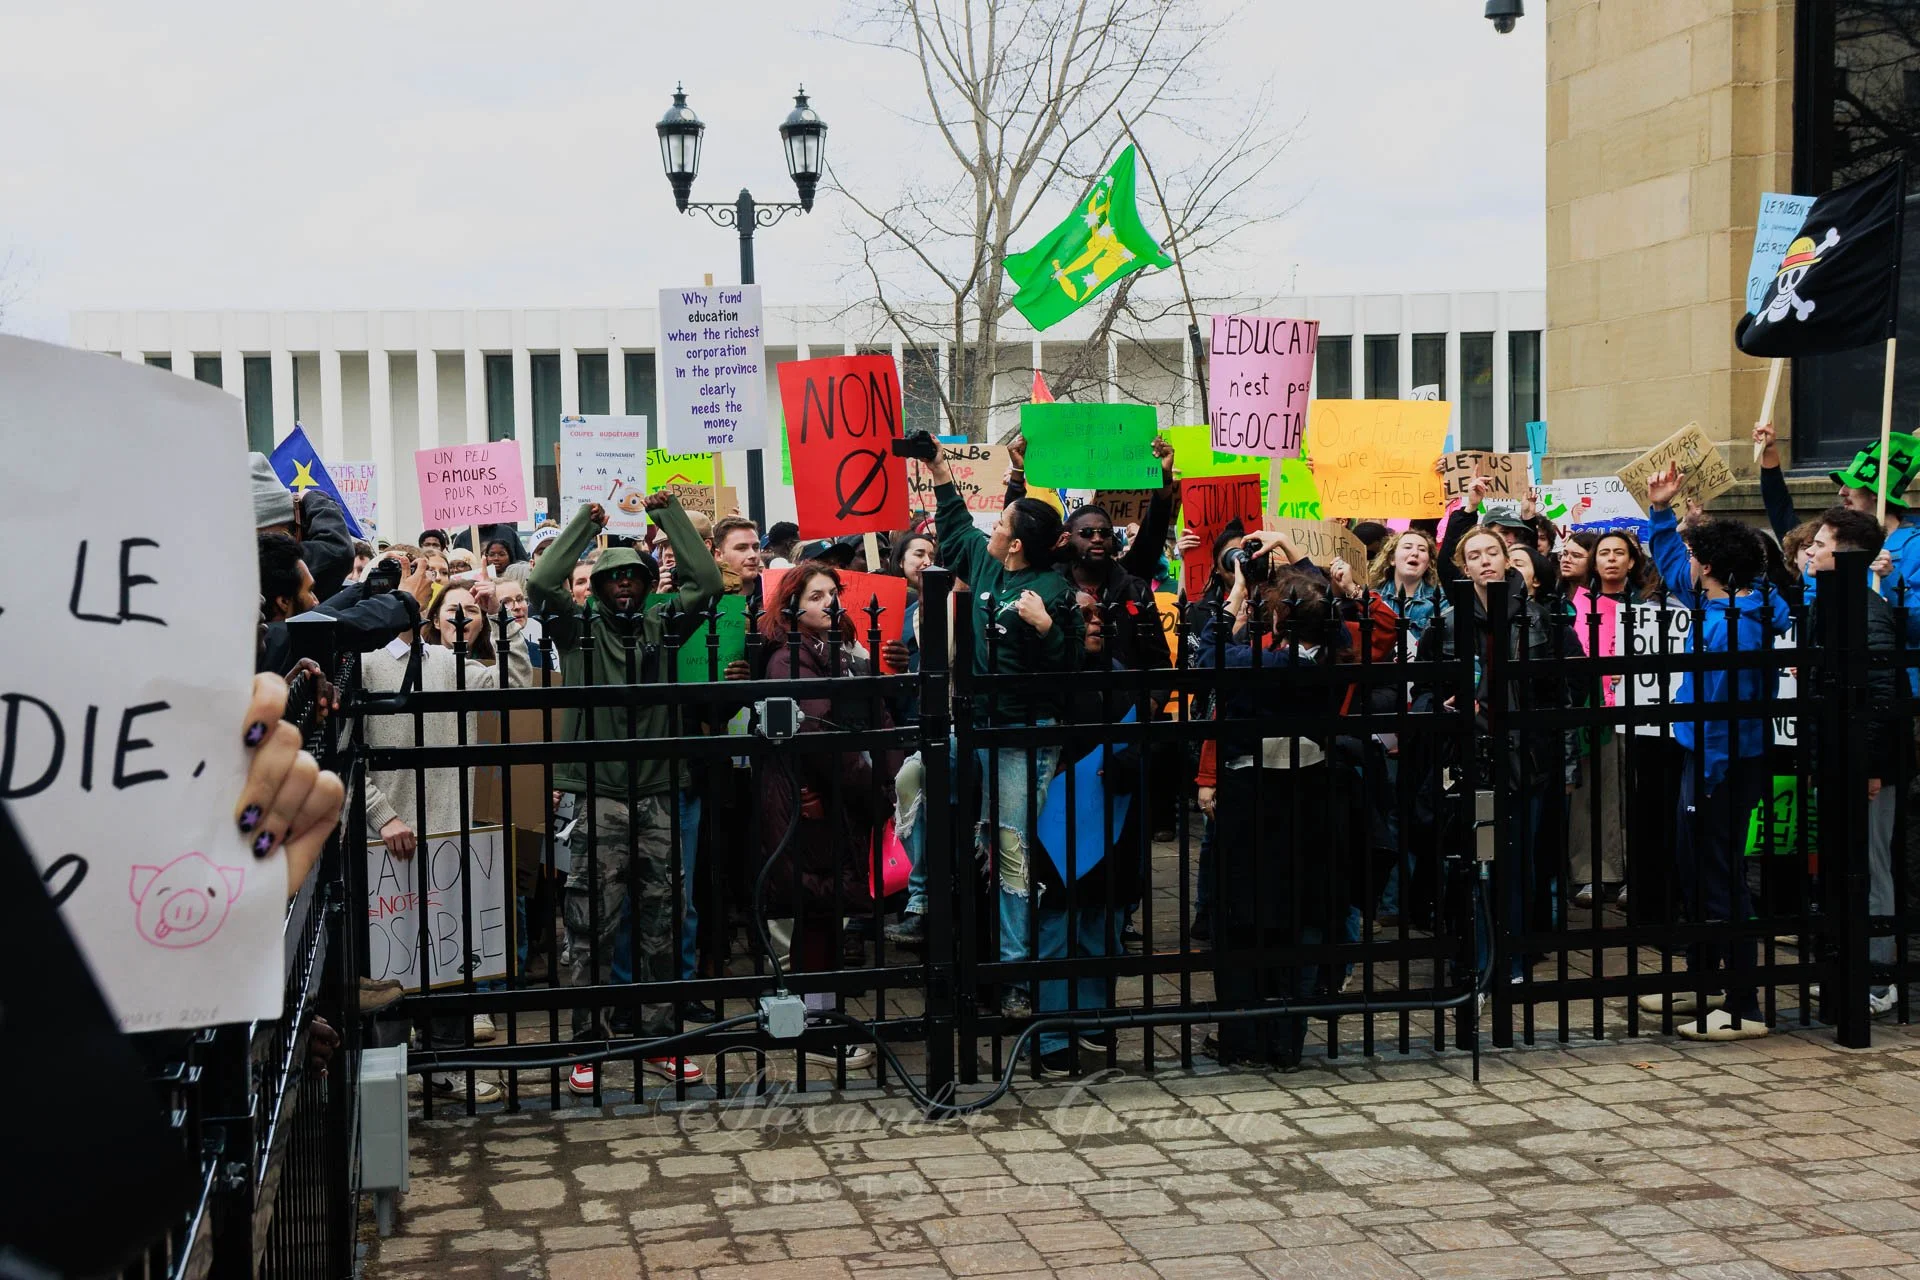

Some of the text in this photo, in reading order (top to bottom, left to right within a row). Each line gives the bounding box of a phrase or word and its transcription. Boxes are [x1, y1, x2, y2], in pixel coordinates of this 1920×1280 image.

[682, 291, 742, 307] Why fund
[688, 310, 739, 323] education
[668, 325, 760, 342] when the richest
[686, 345, 747, 360] corporation
[675, 363, 758, 379] in the province
[700, 383, 736, 399] clearly
[1230, 372, 1270, 398] n'est
[691, 401, 743, 415] needs the
[801, 371, 895, 444] NON
[703, 417, 738, 431] money
[707, 433, 734, 445] more
[434, 450, 489, 464] UN PEU
[969, 446, 991, 461] Be
[1337, 451, 1369, 469] are
[1445, 454, 1512, 472] LET US
[361, 465, 375, 478] EN
[427, 467, 497, 483] D'AMOURS
[445, 483, 507, 500] POUR NOS
[1321, 475, 1444, 511] Negotiable!
[1447, 475, 1510, 496] LERN
[1577, 481, 1598, 495] LES
[682, 497, 703, 506] CUTS
[1109, 499, 1134, 520] THE
[70, 537, 168, 626] LE
